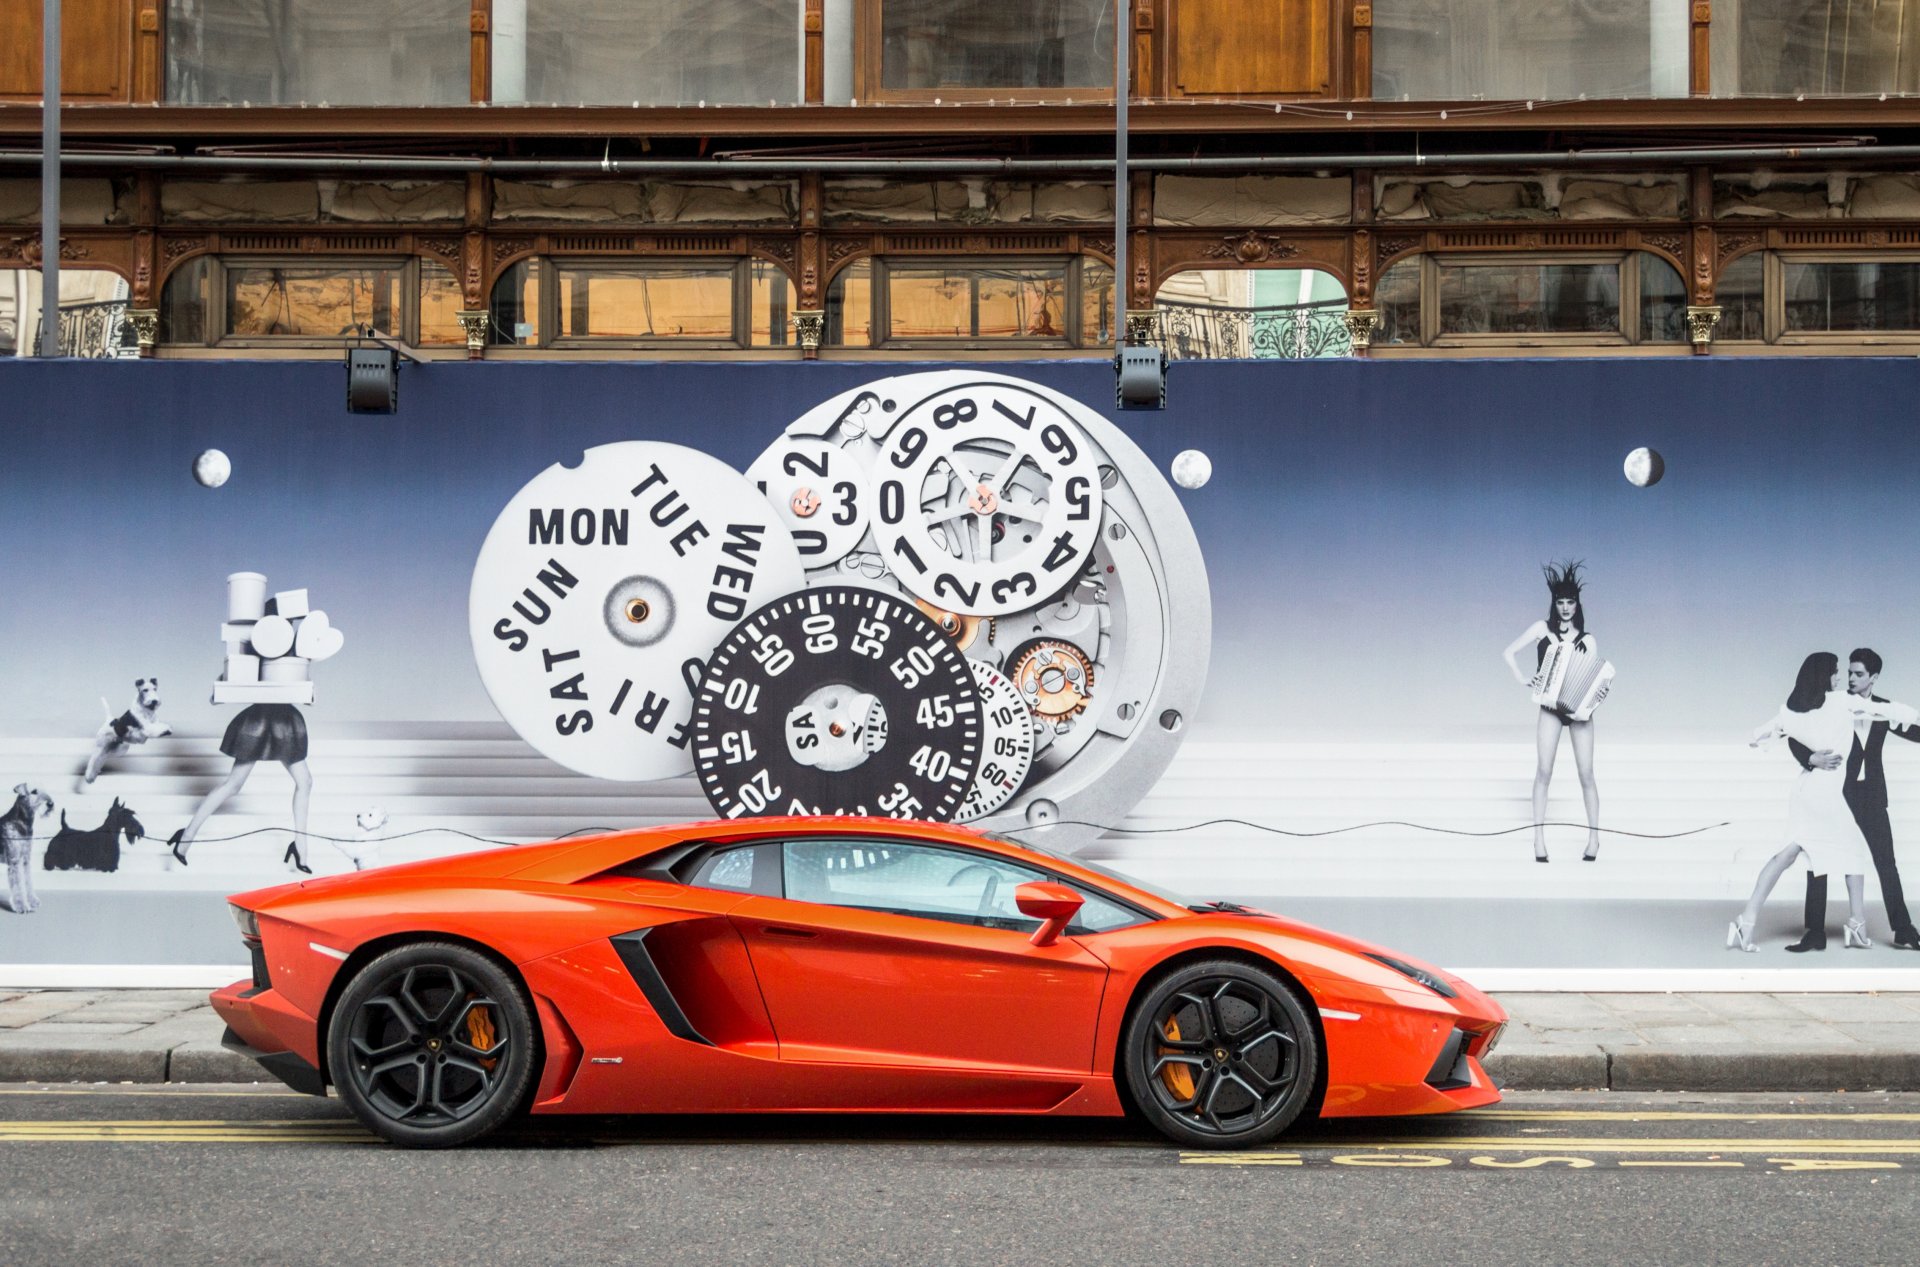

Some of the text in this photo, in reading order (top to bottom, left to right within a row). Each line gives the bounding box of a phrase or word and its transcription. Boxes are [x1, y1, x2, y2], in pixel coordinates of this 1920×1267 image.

[933, 399, 978, 430] 8
[783, 452, 828, 477] 2
[630, 463, 710, 558] TUE
[832, 482, 857, 526] 3
[1065, 477, 1090, 521] 5
[528, 508, 629, 546] MON
[893, 535, 928, 575] 1
[1042, 531, 1078, 573] 4
[707, 524, 766, 622] WED
[934, 573, 982, 608] 2
[992, 572, 1037, 605] 3
[493, 558, 579, 652] SUN
[802, 615, 839, 654] 60
[850, 617, 891, 660] 55
[751, 634, 795, 677] 05
[890, 645, 936, 690] 50
[541, 648, 594, 736] SAT
[724, 677, 761, 715] 10
[608, 678, 693, 751] FRI
[916, 695, 955, 730] 45
[990, 706, 1014, 729] 10
[721, 730, 758, 765] 15
[908, 744, 951, 783] 40
[994, 736, 1018, 758] 05
[738, 769, 782, 814] 20
[981, 761, 1007, 787] 60
